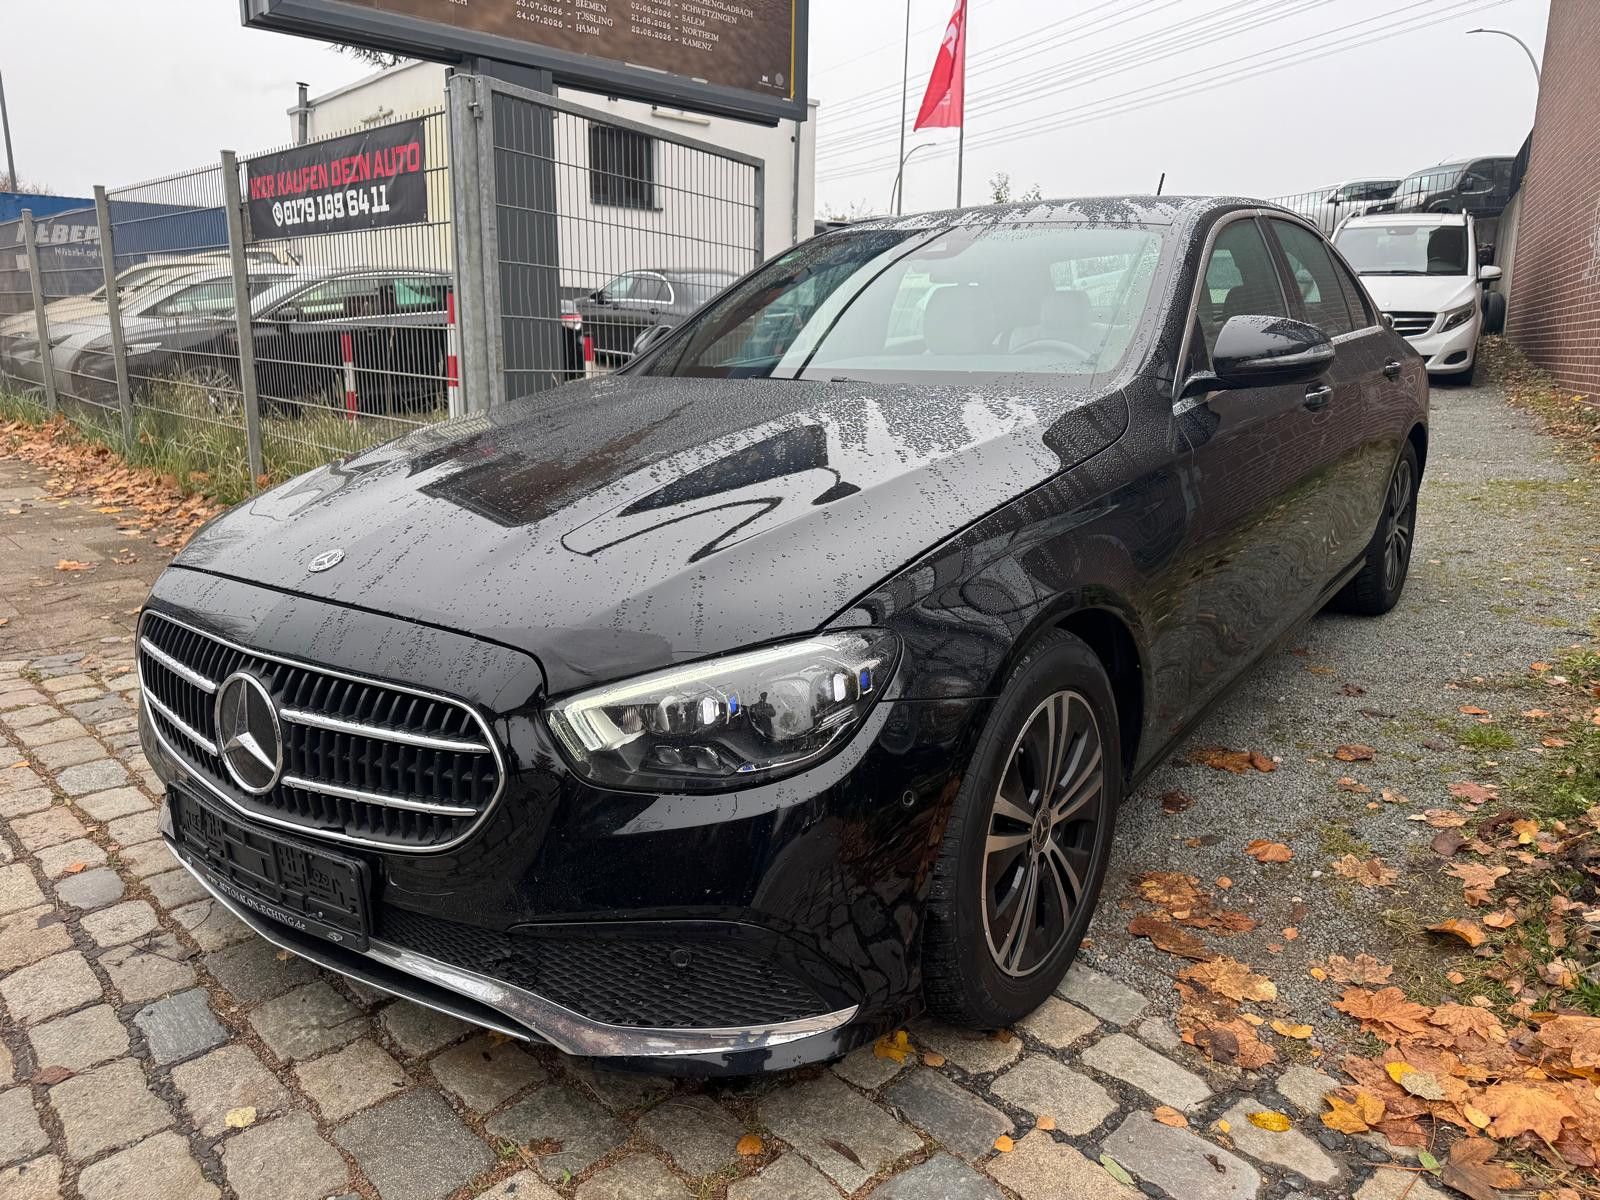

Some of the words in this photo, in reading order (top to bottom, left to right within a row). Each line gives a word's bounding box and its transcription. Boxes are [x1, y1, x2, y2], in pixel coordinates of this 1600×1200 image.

[575, 0, 607, 13] BREMEN
[681, 2, 738, 24] SCHWETZINGEN
[516, 10, 563, 28] 24.07.2026
[575, 23, 600, 36] HAMM
[631, 13, 671, 30] 21.08.2026
[682, 26, 720, 42] NORTHEIM
[681, 14, 705, 27] SALEM
[631, 25, 672, 42] 22.08.2026
[682, 37, 713, 51] KAMENZ
[250, 174, 275, 200] WIR
[277, 163, 329, 196] KAUFEN
[331, 151, 371, 186] DEIN
[373, 142, 420, 179] AUTO
[283, 196, 316, 225] 0179
[316, 191, 345, 221] 109
[346, 188, 370, 217] 64
[370, 184, 390, 214] 11
